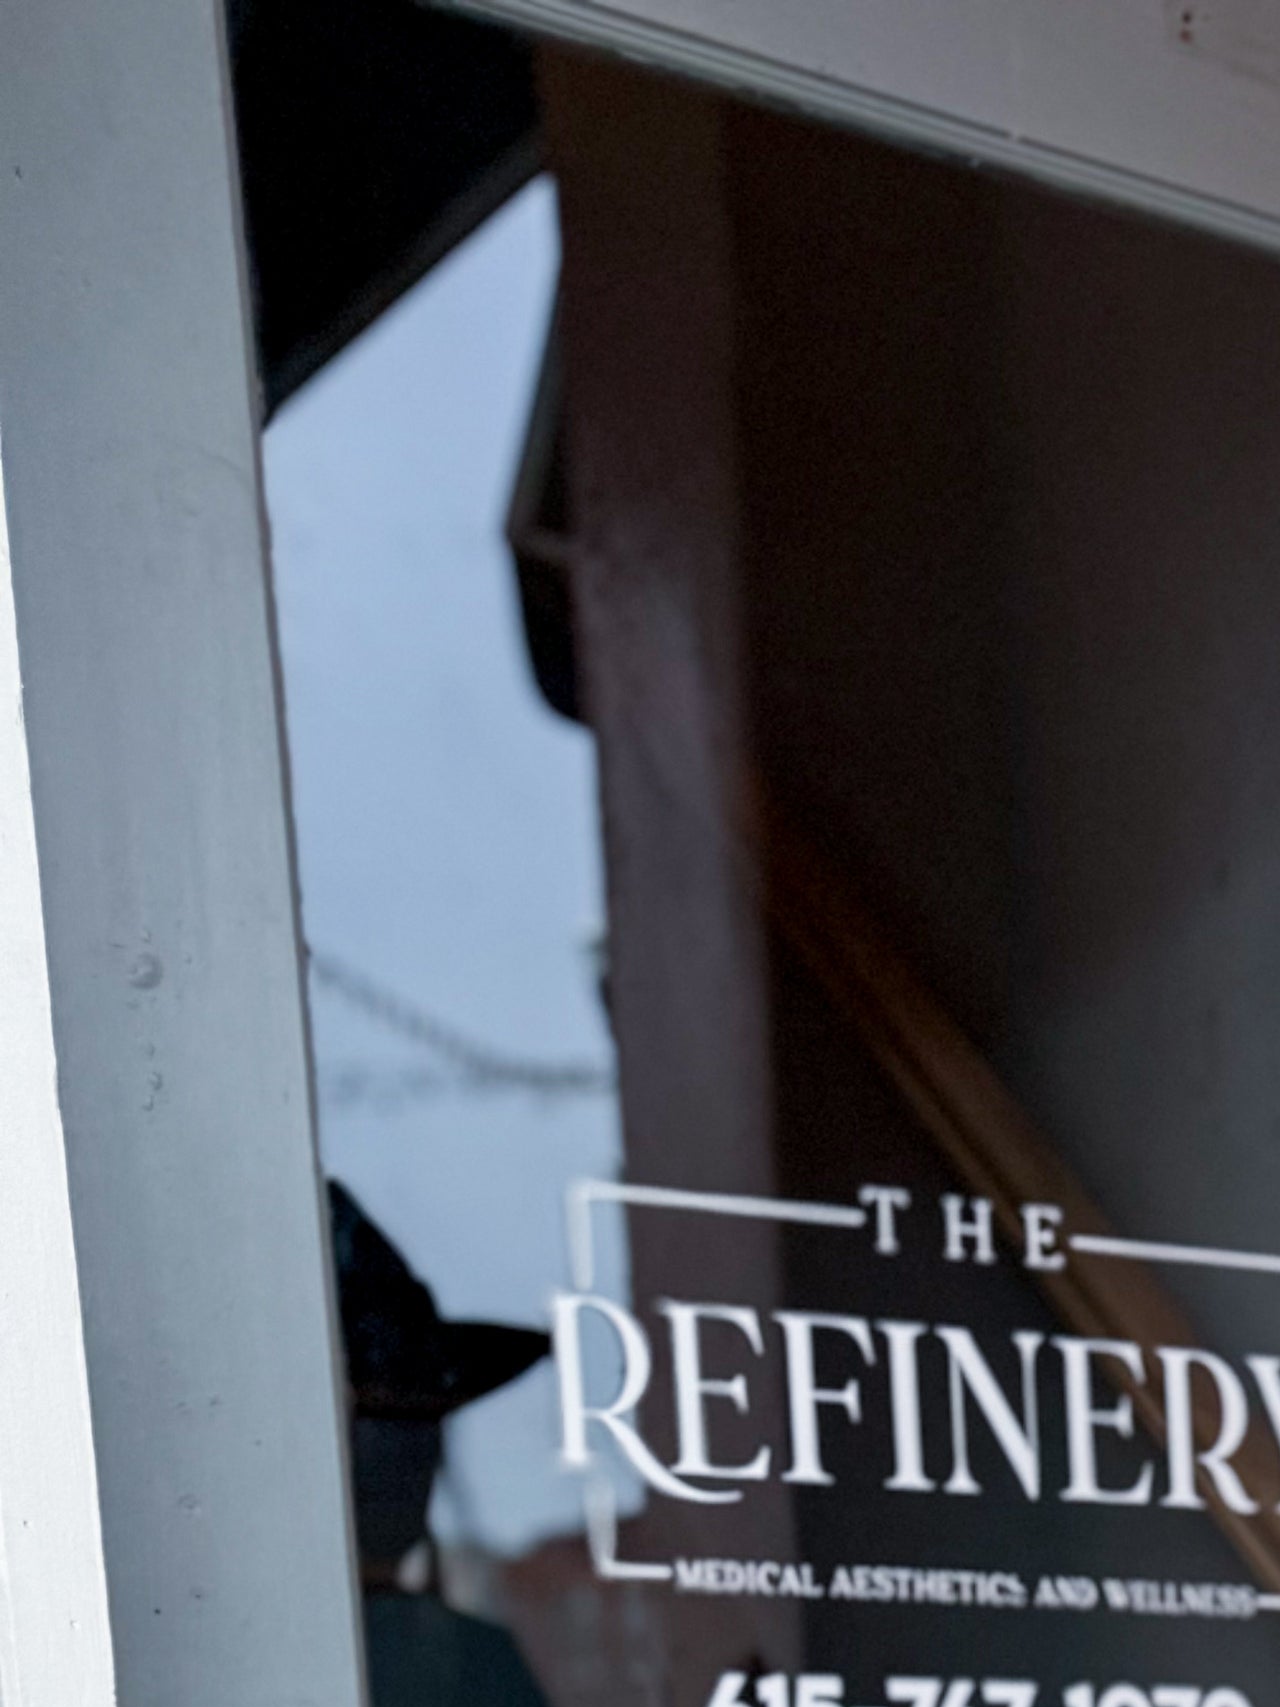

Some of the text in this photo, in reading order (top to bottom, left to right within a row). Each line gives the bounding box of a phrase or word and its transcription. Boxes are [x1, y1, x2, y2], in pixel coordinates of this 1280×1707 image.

[859, 1184, 1067, 1271] THE
[674, 1559, 1257, 1620] MEDICAL AESTHETICS AND WELLNESS
